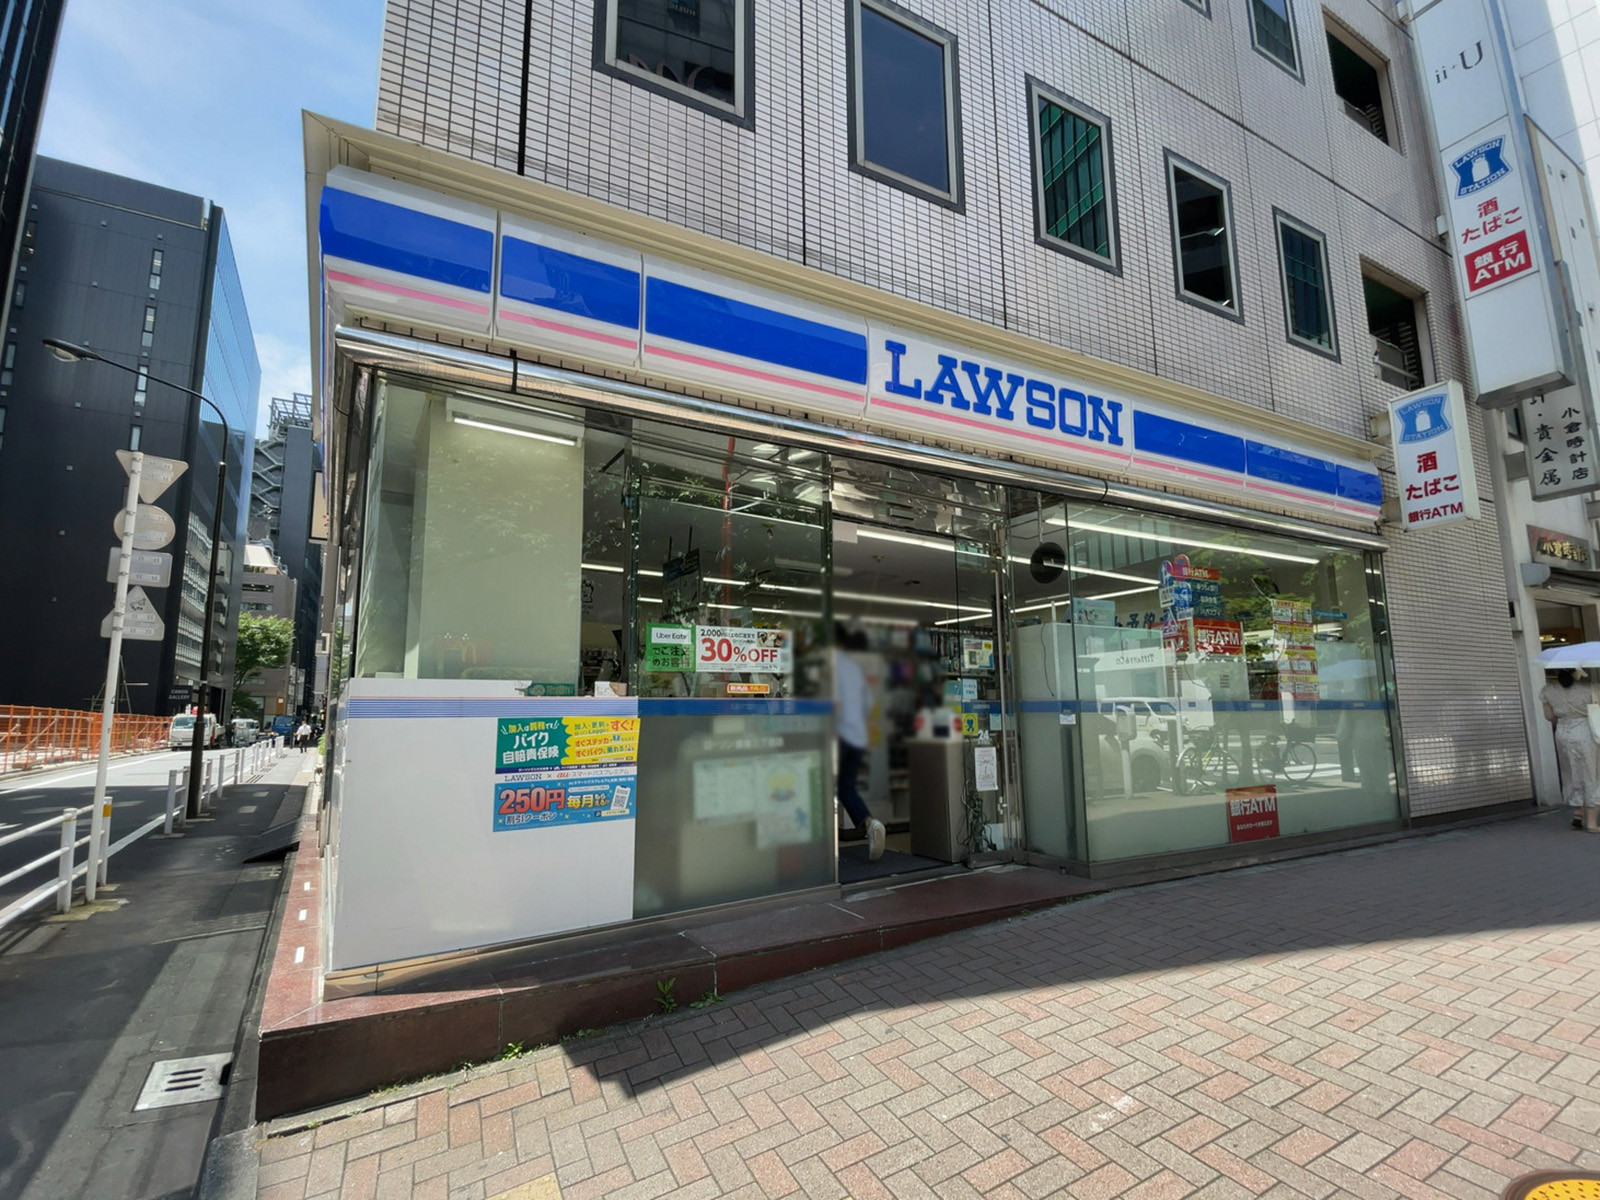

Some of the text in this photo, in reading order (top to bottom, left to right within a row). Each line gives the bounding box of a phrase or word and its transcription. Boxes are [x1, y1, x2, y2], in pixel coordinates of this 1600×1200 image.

[1454, 139, 1501, 168] LAWSON
[1460, 168, 1506, 195] STATION
[1477, 196, 1499, 219] 酒
[1461, 206, 1523, 244] たばこ
[1473, 240, 1519, 270] 銀行
[1474, 251, 1527, 284] ATM
[885, 339, 1123, 446] LAWSON
[1401, 397, 1442, 415] LAWSON
[1404, 424, 1445, 441] STATION
[1561, 407, 1590, 480] 小倉時計店
[1416, 451, 1438, 474] 酒
[1405, 474, 1460, 501] たばこ
[1408, 502, 1464, 523] 銀行ATM
[656, 632, 687, 640] Uber Eats
[1197, 629, 1240, 646] 銀行ATM
[513, 731, 549, 749] バイク
[502, 745, 559, 764] 自賠責保険
[504, 773, 542, 782] LAWSON
[499, 787, 566, 815] 250円
[567, 794, 594, 809] 毎月
[1230, 796, 1276, 817] 銀行ATM
[506, 812, 557, 825] 割引クーポン
